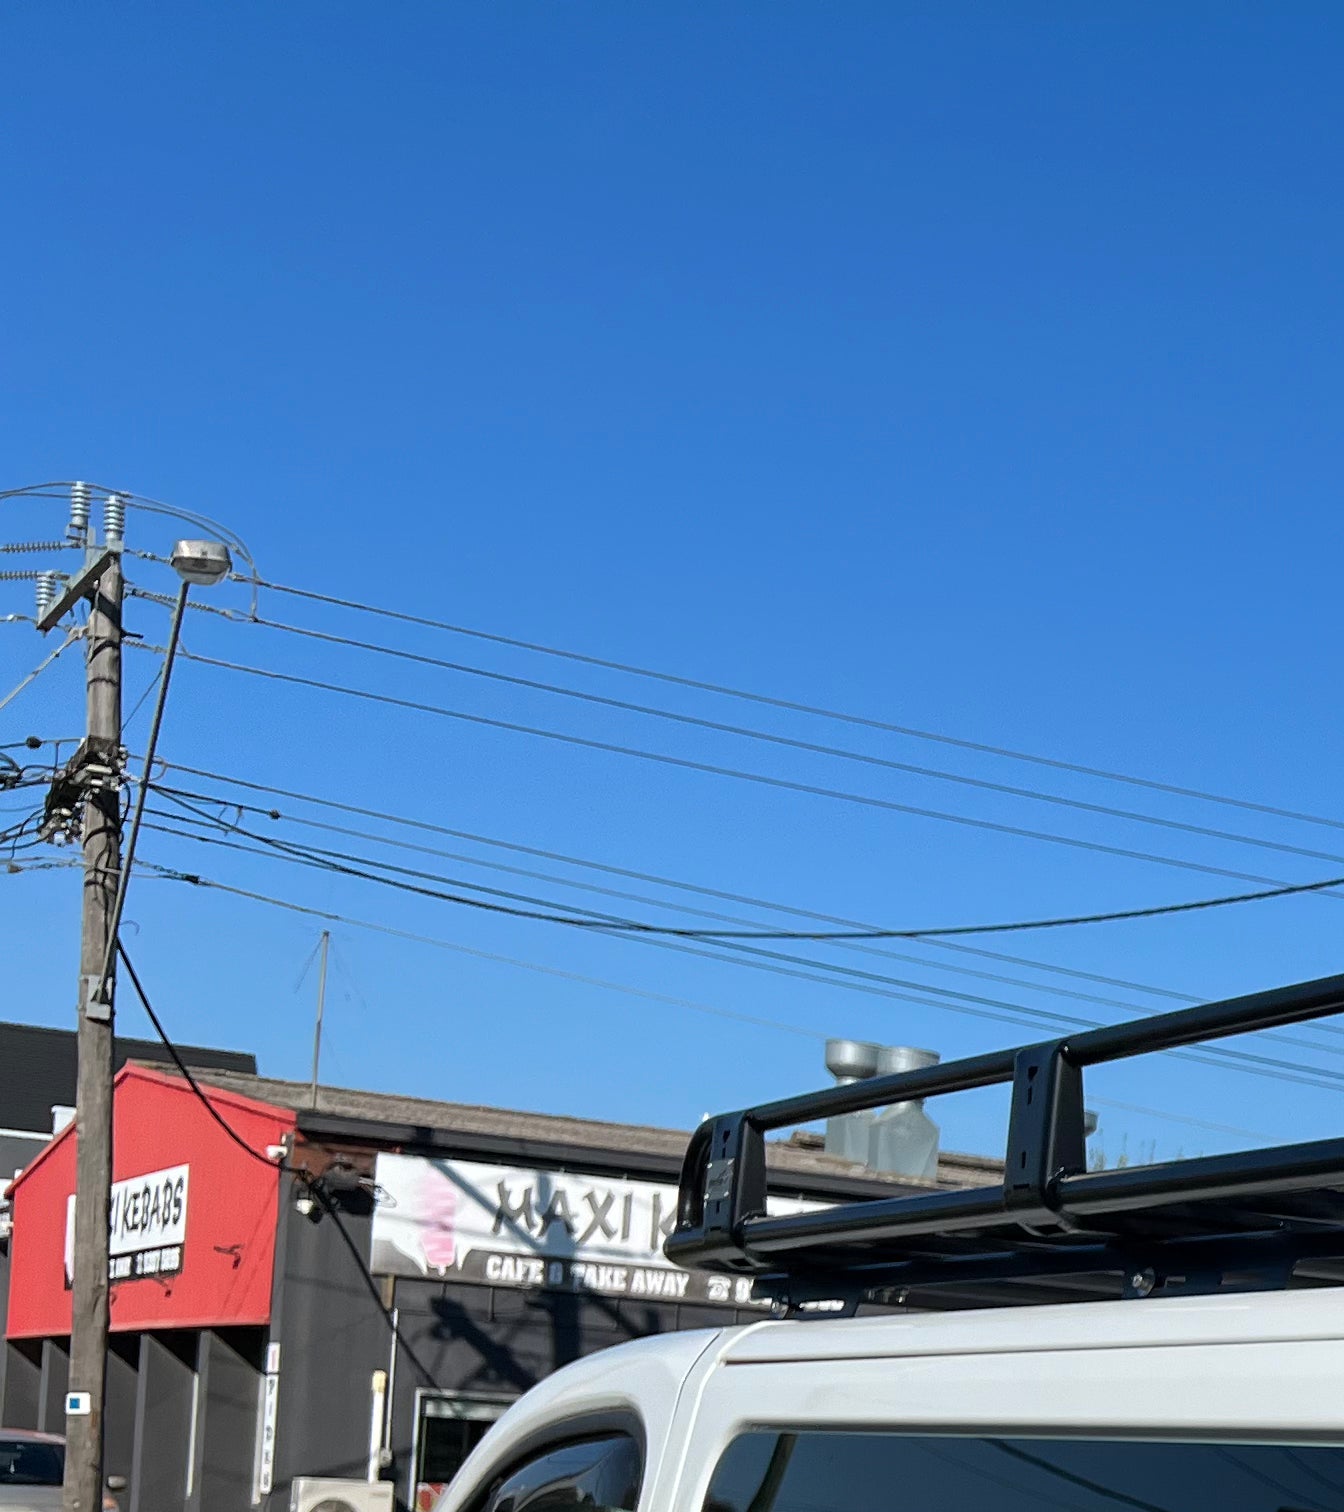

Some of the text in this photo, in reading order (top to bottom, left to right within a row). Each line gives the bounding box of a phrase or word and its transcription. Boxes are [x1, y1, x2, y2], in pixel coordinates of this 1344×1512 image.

[120, 1176, 184, 1240] KEBABS
[491, 1180, 634, 1246] MAXI
[486, 1253, 544, 1285] CAFE
[571, 1262, 628, 1294] TAKE
[630, 1267, 691, 1298] AWAY
